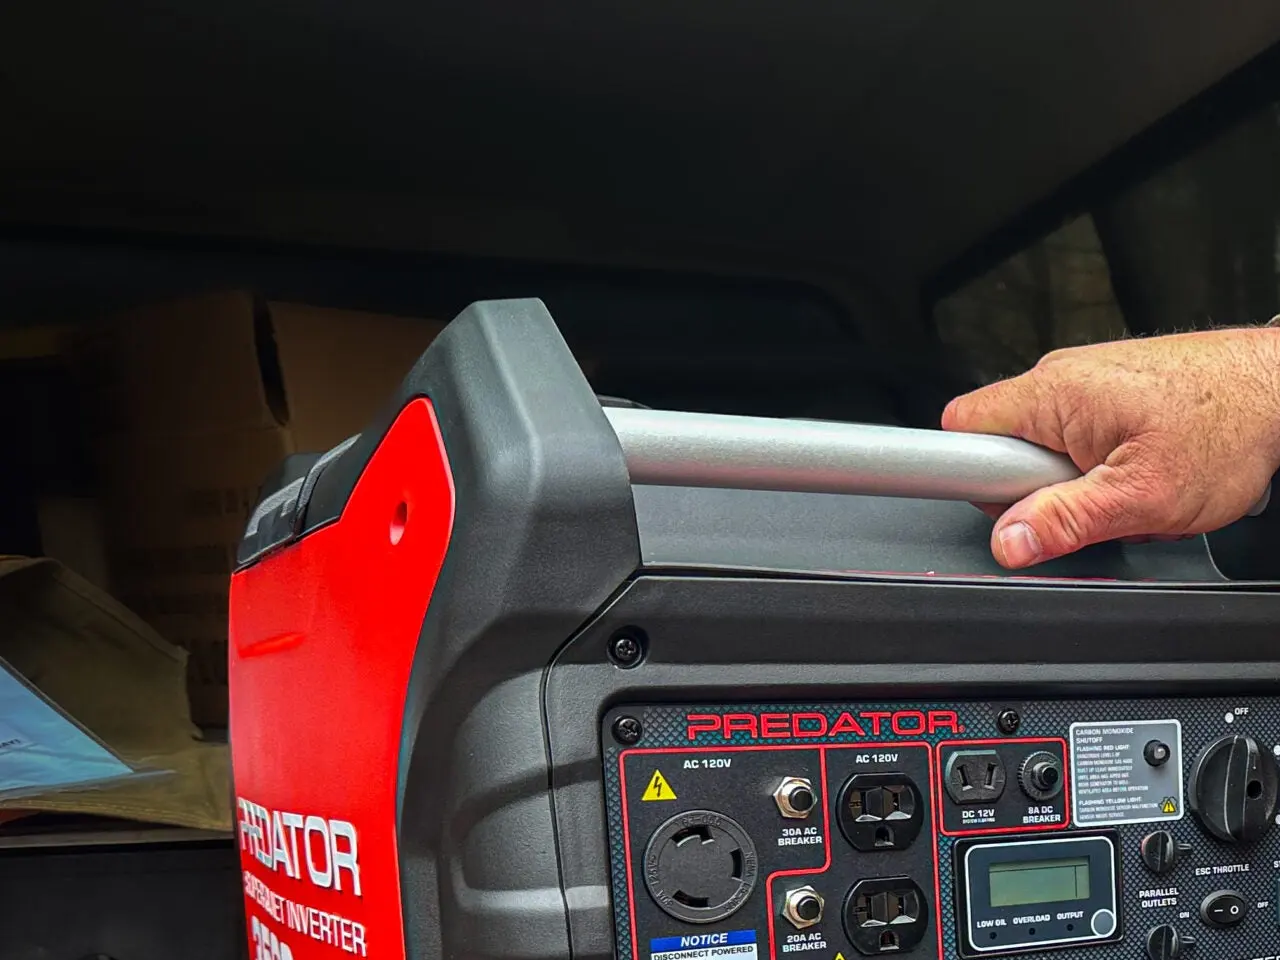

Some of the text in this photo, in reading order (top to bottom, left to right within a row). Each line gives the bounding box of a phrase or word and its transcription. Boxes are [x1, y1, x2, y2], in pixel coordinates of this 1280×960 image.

[1234, 707, 1249, 715] OFF
[687, 710, 959, 739] PREDATOR
[683, 758, 732, 769] AC 120V
[855, 754, 899, 764] AC 120V
[962, 809, 995, 818] DC 12V
[1028, 806, 1040, 814] 8A
[1022, 814, 1061, 824] BREAKER
[782, 827, 817, 837] 30A AC
[778, 836, 822, 846] BREAKER
[1195, 864, 1250, 876] ESC THROTTLE
[1138, 887, 1179, 898] PARALLEL
[1141, 898, 1177, 908] OUTLETS
[1013, 914, 1051, 925] OVERLOAD
[1057, 911, 1084, 920] OUTPUT
[286, 899, 367, 957] INVERTER
[976, 919, 1007, 929] LOW OIL
[681, 933, 729, 947] NOTICE
[786, 933, 822, 943] 20A AC
[711, 945, 754, 957] POWERED
[782, 941, 827, 952] BREAKER
